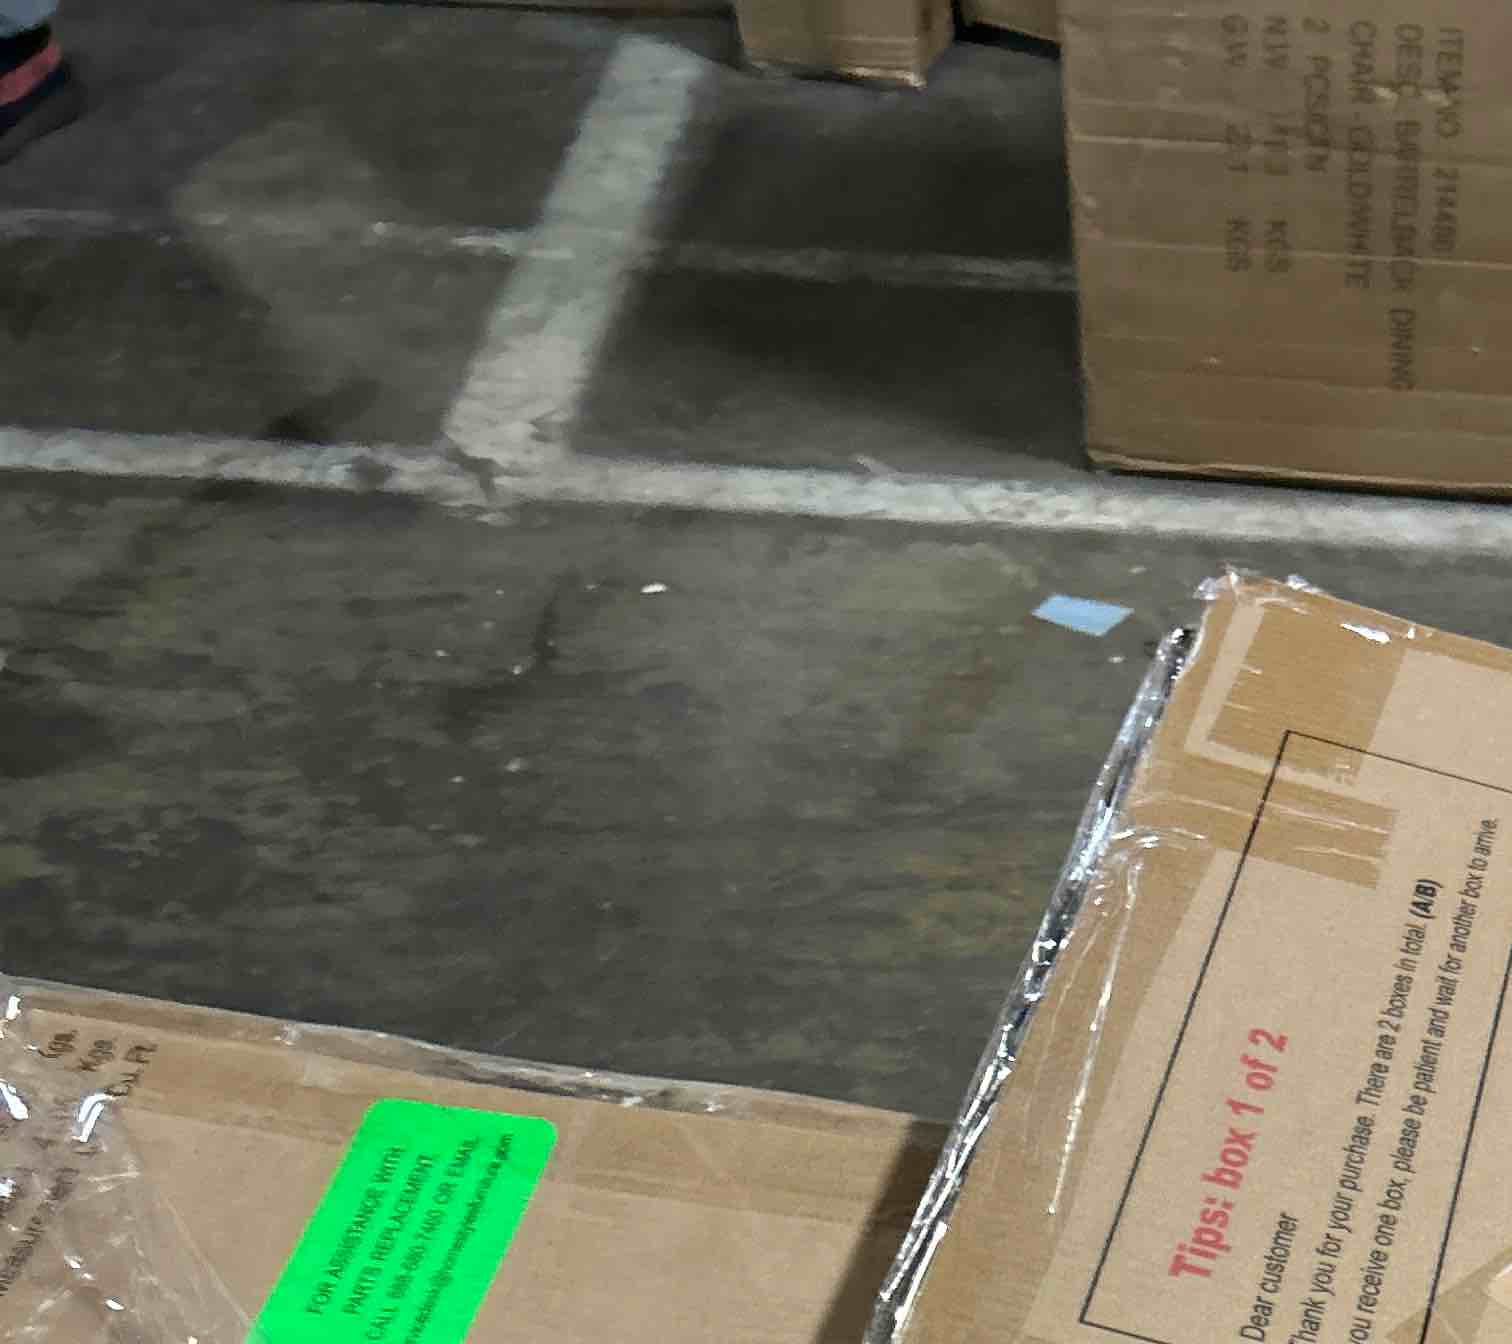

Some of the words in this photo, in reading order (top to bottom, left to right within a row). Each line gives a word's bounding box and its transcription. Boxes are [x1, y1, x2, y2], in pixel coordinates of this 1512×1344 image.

[1473, 817, 1499, 858] arrive.
[1467, 853, 1489, 872] to
[1409, 878, 1444, 920] (A/B)
[1456, 872, 1484, 899] box
[1450, 902, 1479, 953] another
[1393, 956, 1416, 972] in
[1438, 954, 1463, 978] for
[1382, 974, 1413, 1018] boxes
[1435, 973, 1459, 1008] wait
[1248, 1028, 1288, 1052] 2
[1377, 1018, 1400, 1033] 2
[1427, 1005, 1450, 1038] and
[1376, 1033, 1396, 1062] are
[1412, 1035, 1443, 1095] patient
[1240, 1053, 1278, 1091] of
[1356, 1058, 1389, 1106] There
[1226, 1098, 1264, 1116] 1
[1401, 1093, 1428, 1116] be
[1202, 1127, 1257, 1191] box
[1339, 1115, 1376, 1193] purchase.
[1389, 1114, 1423, 1175] please
[326, 1187, 387, 1279] ASSISTANCE
[371, 1145, 406, 1184] WITH
[1328, 1191, 1354, 1234] your
[1379, 1176, 1412, 1214] box,
[343, 1265, 382, 1315] PARTS
[369, 1152, 434, 1262] REPLACEMENT
[365, 1306, 398, 1341] CALL
[433, 1182, 459, 1205] OR
[446, 1136, 481, 1178] EMAIL
[1168, 1197, 1235, 1279] Tips:
[1315, 1233, 1345, 1260] for
[1374, 1213, 1399, 1247] one
[1239, 1295, 1273, 1343] Dear
[1261, 1212, 1299, 1295] customer
[1311, 1253, 1337, 1296] you
[1357, 1248, 1389, 1318] receive
